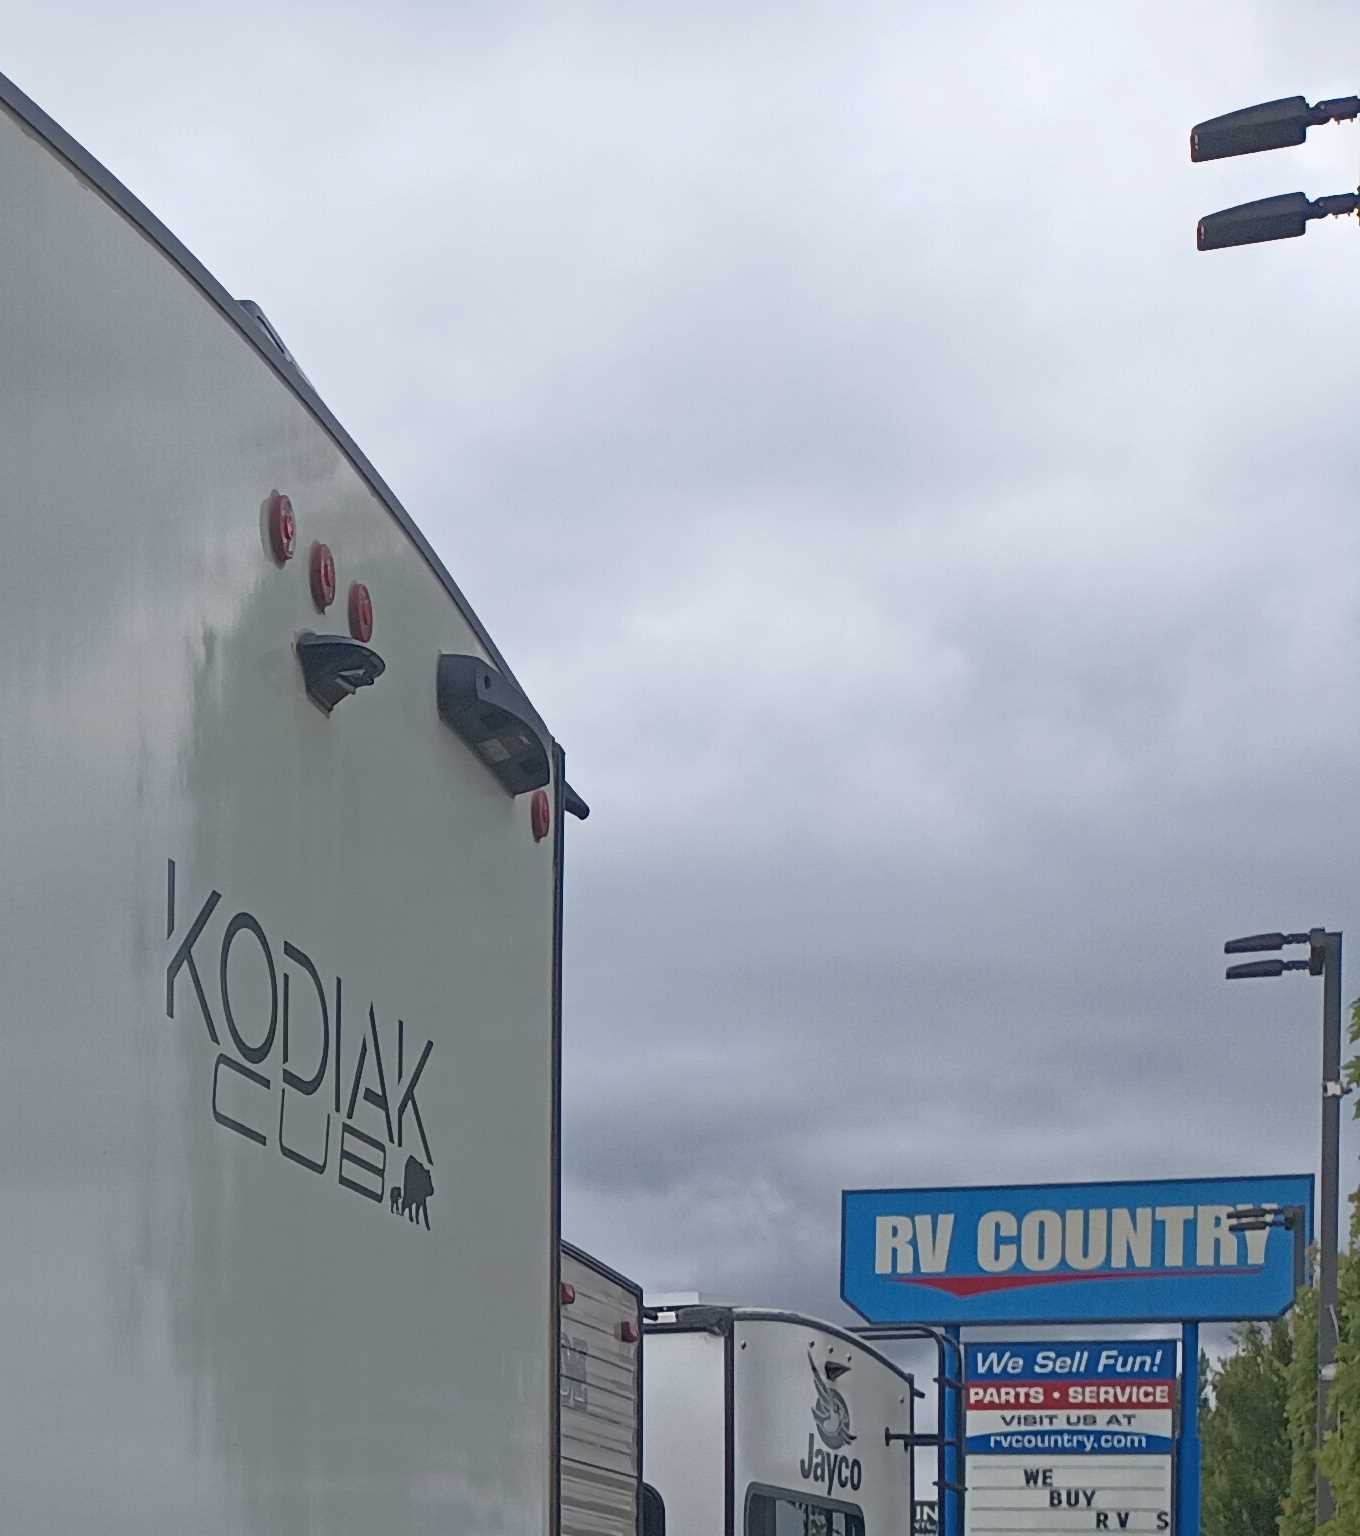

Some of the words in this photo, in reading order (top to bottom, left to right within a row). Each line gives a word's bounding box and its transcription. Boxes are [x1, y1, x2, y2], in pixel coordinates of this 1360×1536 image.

[166, 858, 433, 1165] KODIAK
[875, 1213, 955, 1275] RV
[977, 1203, 1278, 1273] COUNTRY
[976, 1351, 1024, 1374] We
[1034, 1351, 1088, 1373] Sell
[1097, 1350, 1163, 1374] Fun!
[969, 1387, 1045, 1404] PARTS
[1068, 1386, 1169, 1403] SERVICE
[1000, 1414, 1058, 1426] VISIT
[1066, 1414, 1097, 1426] US
[1106, 1414, 1136, 1426] AT
[990, 1433, 1146, 1451] rvcountry.com
[800, 1433, 861, 1496] Jayco
[1024, 1469, 1053, 1487] WE
[1049, 1489, 1096, 1507] BUY
